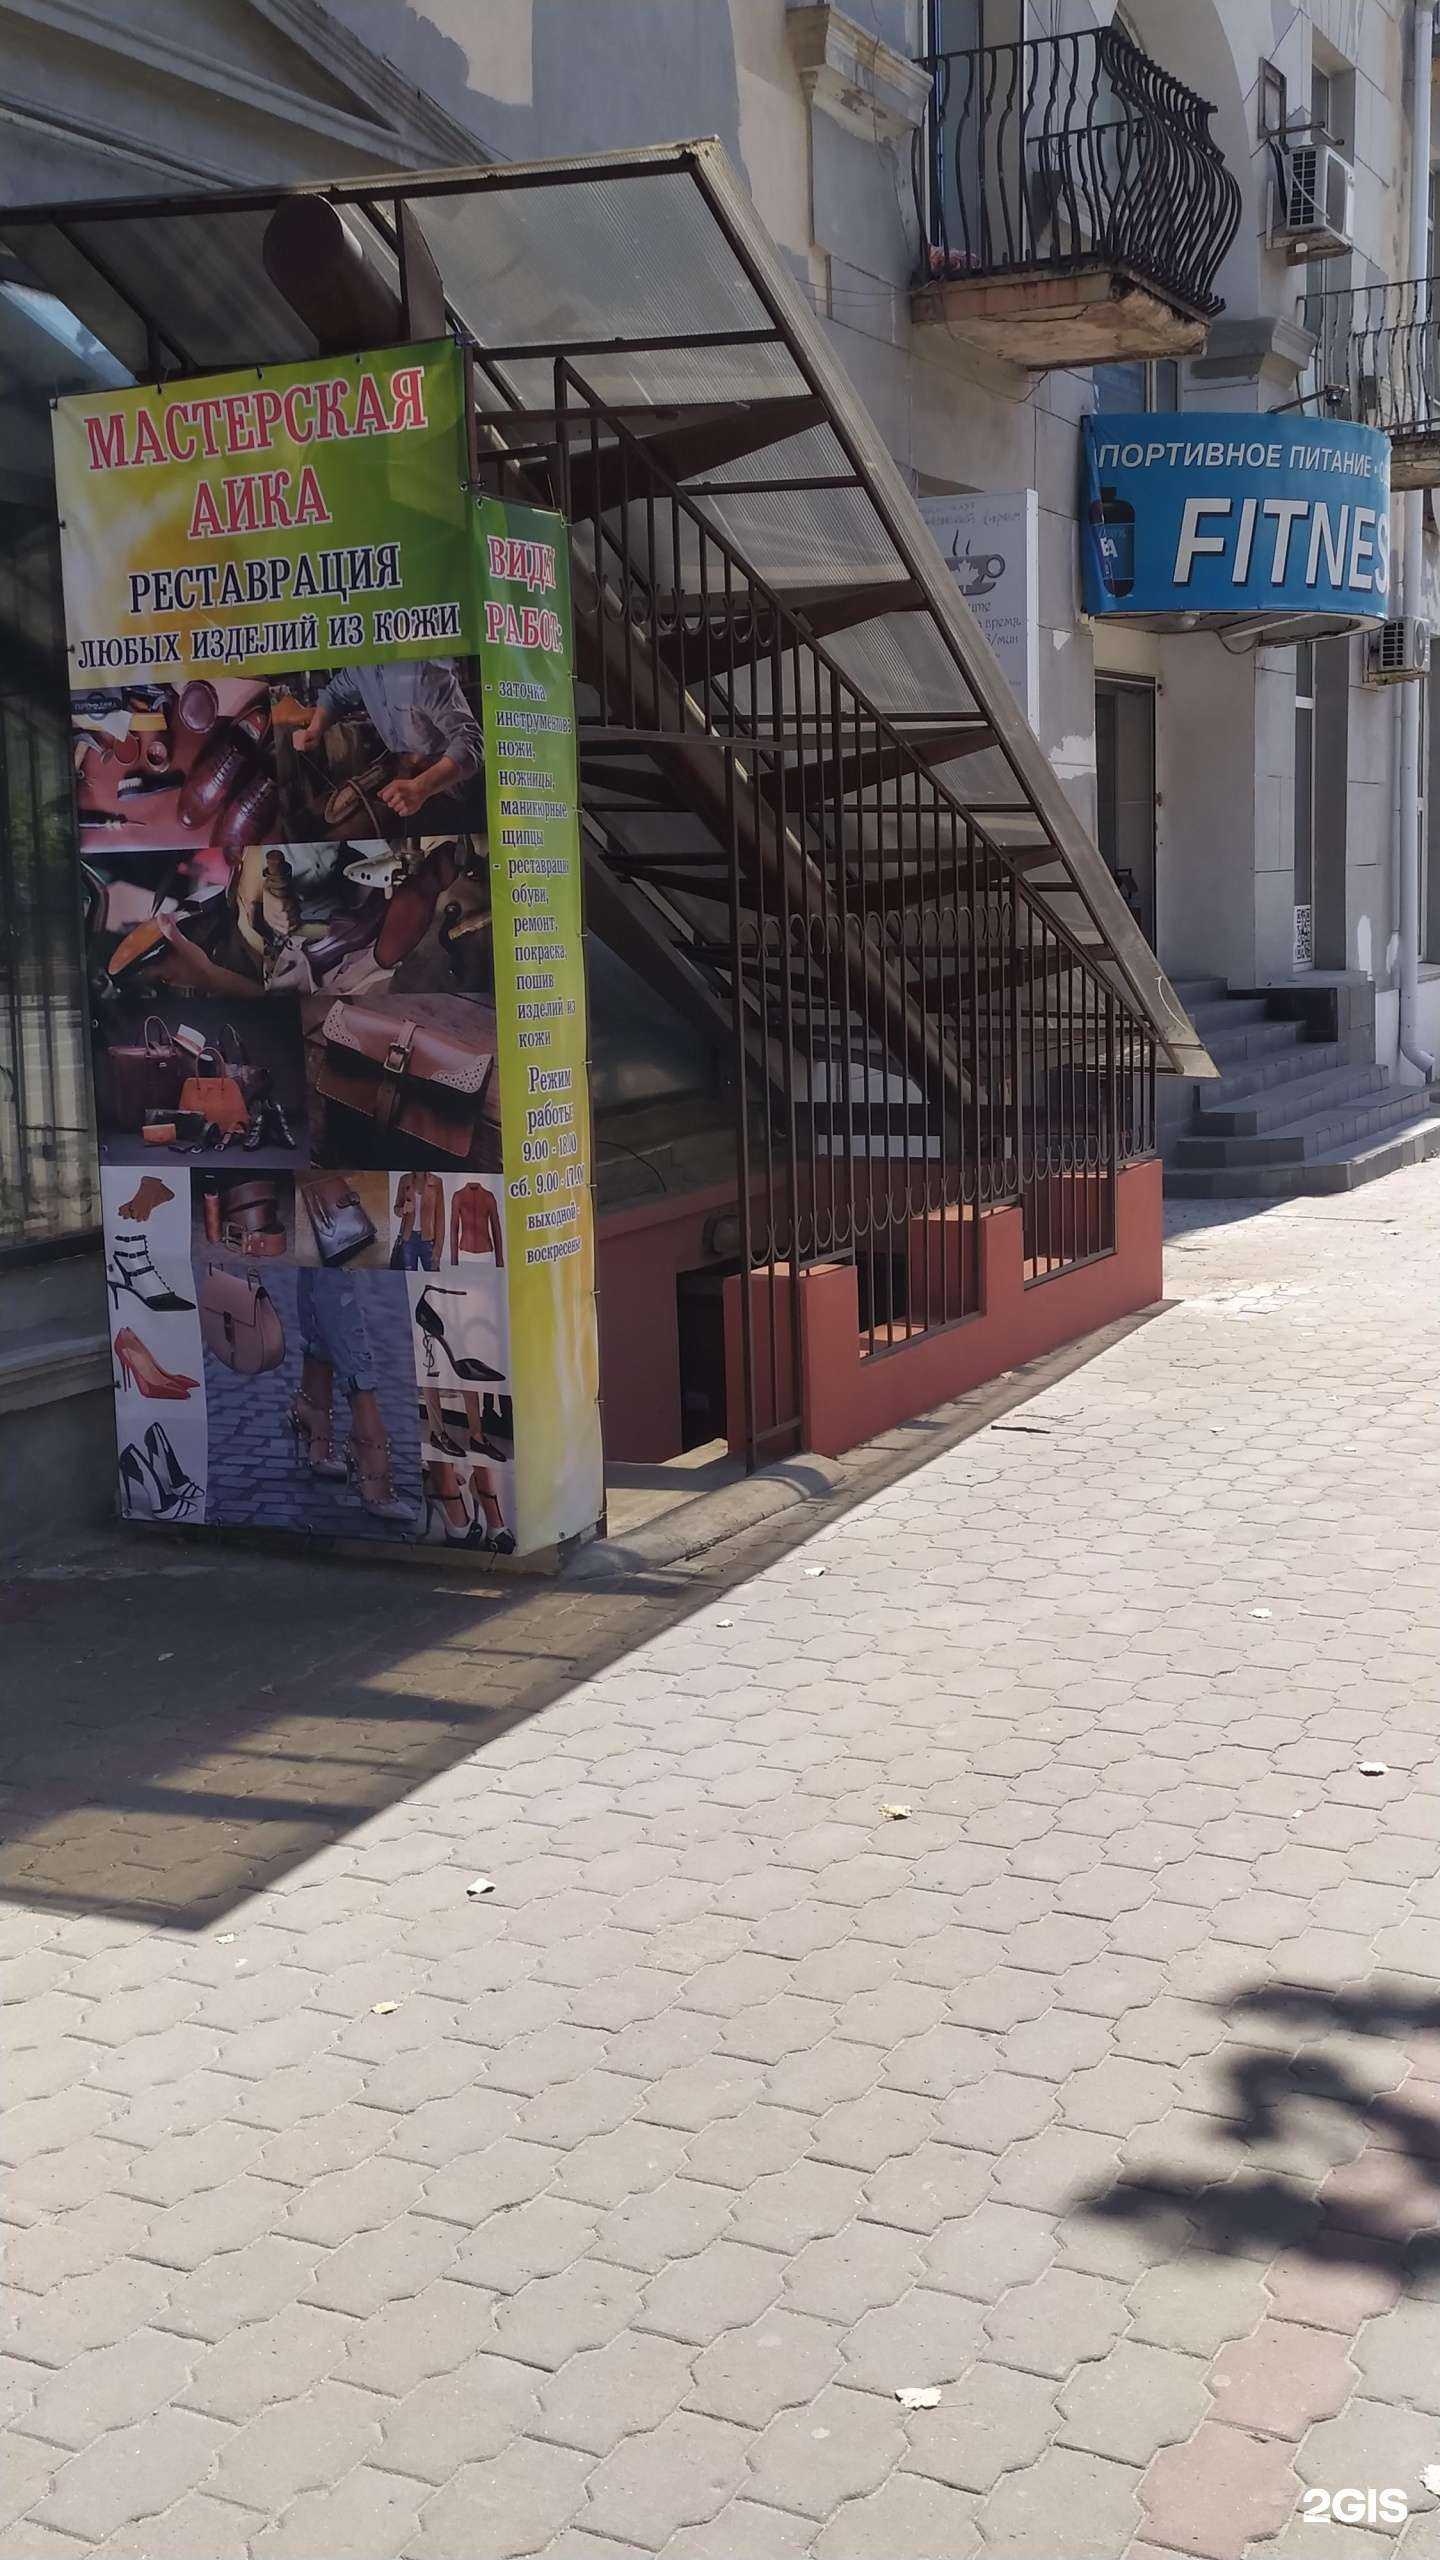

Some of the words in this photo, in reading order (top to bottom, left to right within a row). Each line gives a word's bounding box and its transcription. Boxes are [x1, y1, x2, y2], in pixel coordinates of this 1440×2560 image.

[84, 366, 428, 471] МАСТЕРСКАЯ
[1095, 442, 1282, 468] ПОРТИВНОЕ
[1289, 445, 1373, 478] ПИТАНИЕ
[189, 465, 331, 540] АИКА
[487, 535, 556, 594] ВИДЫ
[129, 542, 402, 615] РЕСТАВРАЦИЯ
[78, 633, 181, 670] ЛЮБЫХ
[191, 614, 319, 664] ИЗДЕЛИЙ
[327, 612, 364, 647] ИЗ
[374, 603, 461, 643] КОЖИ
[499, 681, 546, 700] заточка
[500, 800, 567, 822] маникюрные
[502, 830, 543, 847] щипцы
[516, 974, 554, 990] пошив
[518, 997, 564, 1020] изделий
[518, 1031, 551, 1048] кожи
[528, 1066, 572, 1093] Режим
[523, 1140, 549, 1161] 9.00
[510, 1177, 531, 1198] сб.
[536, 1172, 559, 1194] 9.00
